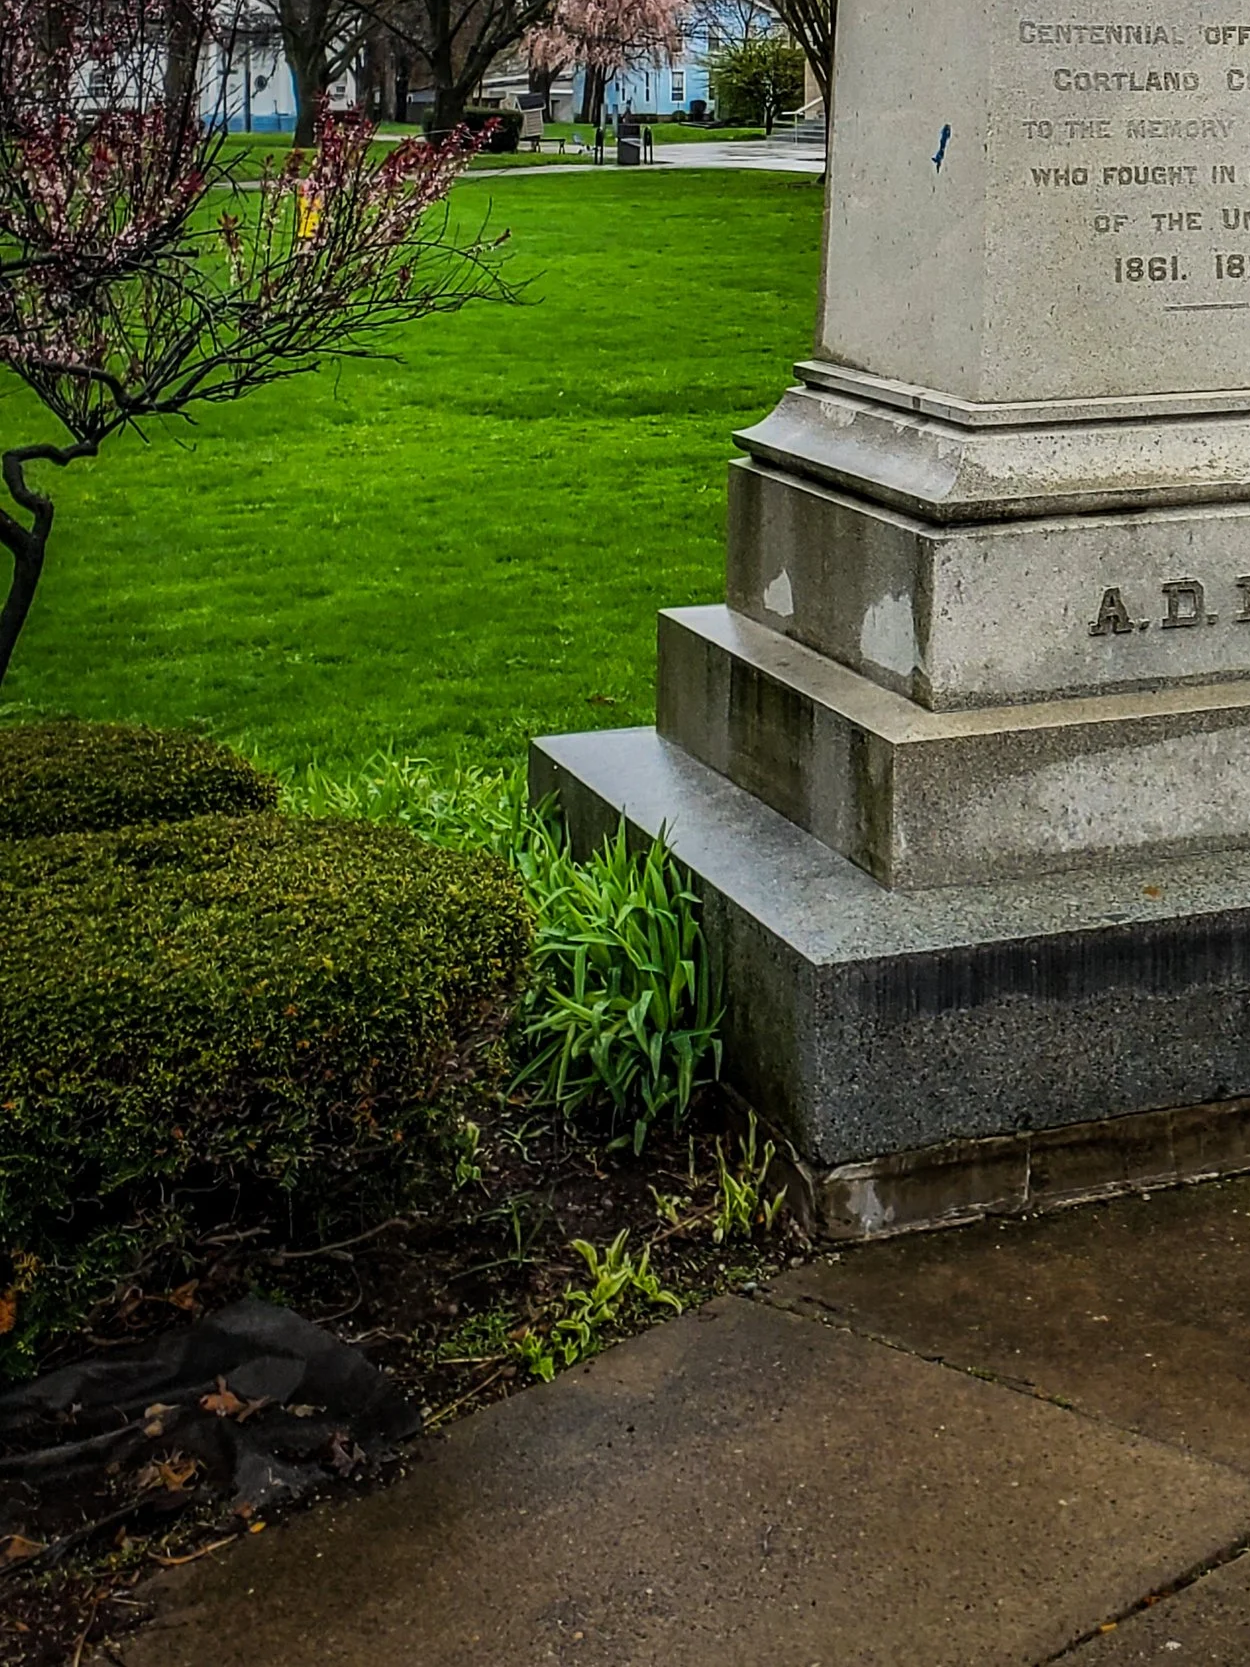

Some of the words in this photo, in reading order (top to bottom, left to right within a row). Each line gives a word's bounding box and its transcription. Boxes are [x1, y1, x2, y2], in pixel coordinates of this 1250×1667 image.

[1053, 68, 1200, 91] CORTLAND
[1022, 120, 1052, 139] TO
[1065, 119, 1111, 139] THE
[1127, 118, 1234, 139] MEMORY
[1031, 166, 1088, 186] WHO
[1103, 165, 1197, 185] FOUGHT
[1212, 165, 1235, 184] IN
[1094, 214, 1128, 232] OF
[1151, 211, 1202, 231] THE
[1115, 255, 1188, 283] 1861.
